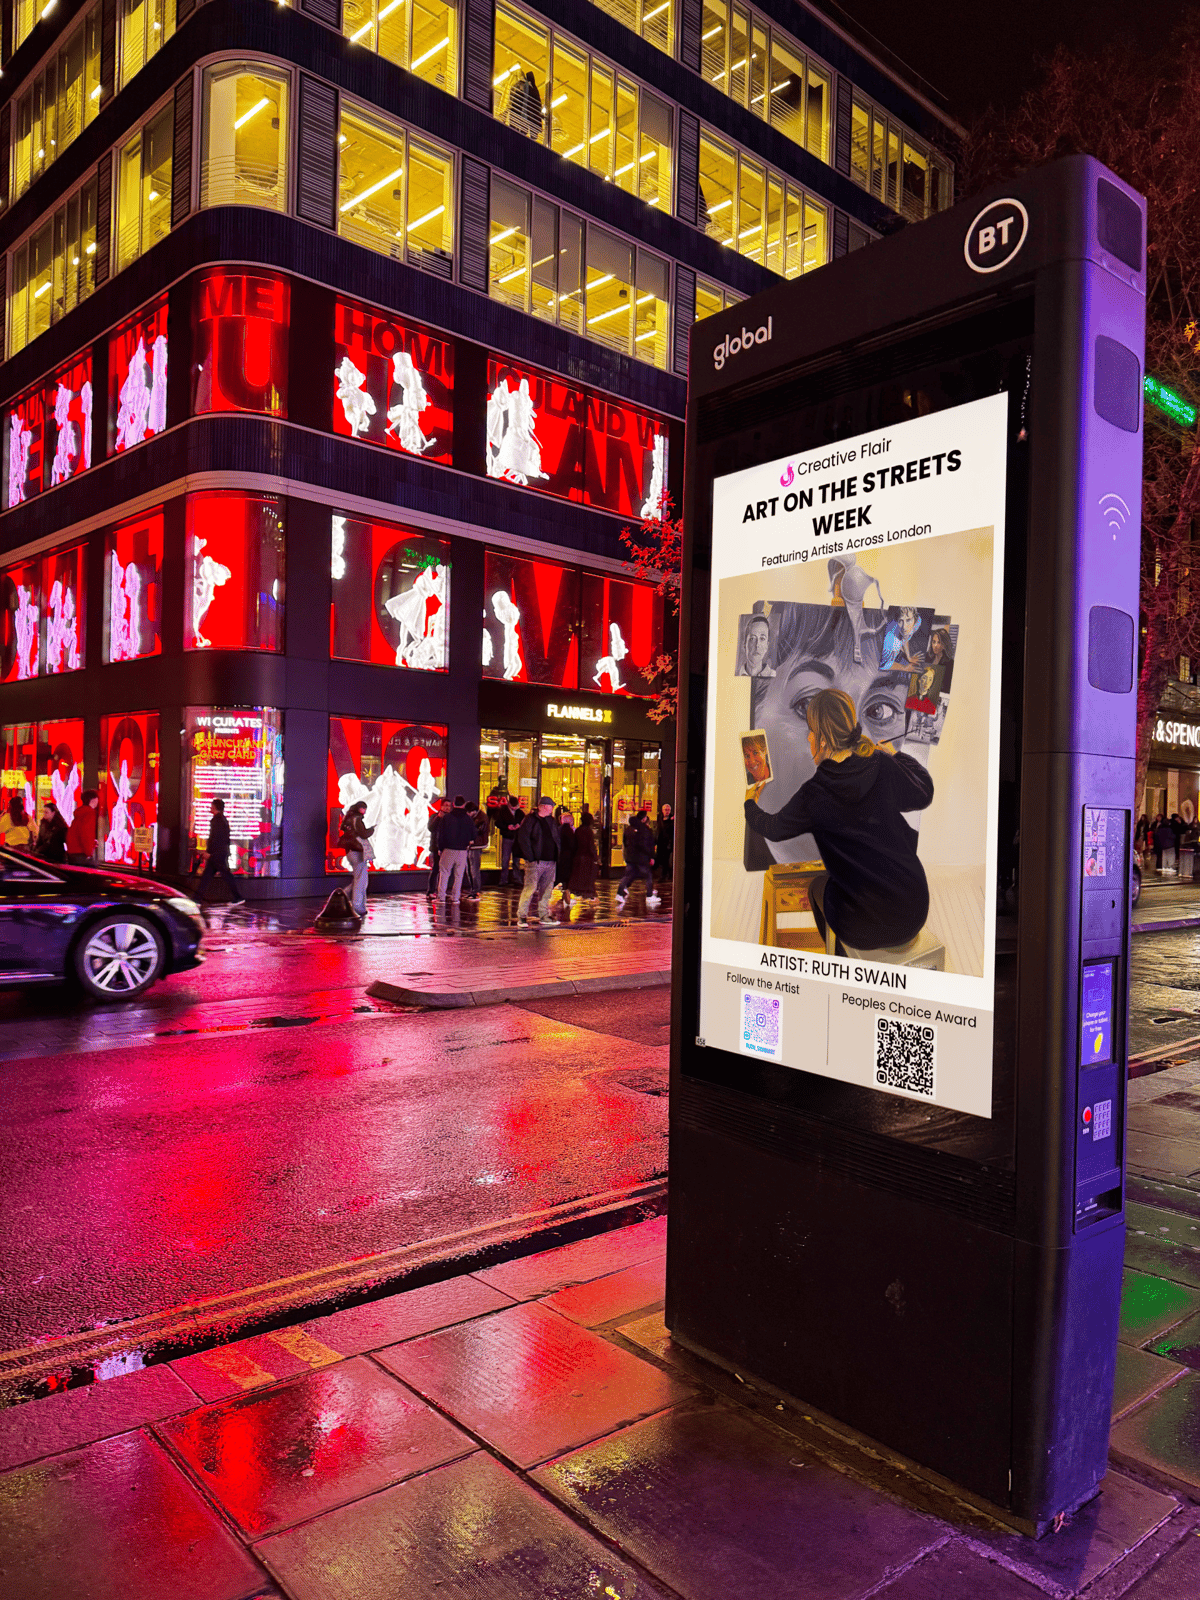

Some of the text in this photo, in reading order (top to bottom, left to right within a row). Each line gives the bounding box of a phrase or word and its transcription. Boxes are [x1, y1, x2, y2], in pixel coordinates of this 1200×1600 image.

[979, 216, 1014, 255] BT
[713, 315, 773, 370] global
[797, 437, 892, 476] Creative Flair
[742, 449, 962, 523] ART ON THE STREETS
[812, 505, 873, 536] WEEK
[761, 522, 932, 567] Featuring Artists Across London
[212, 716, 262, 728] CURATES
[1156, 720, 1165, 742] &
[487, 796, 528, 808] SAE
[726, 971, 800, 995] Follow the Artist
[760, 952, 907, 990] ARTIST: RUTH SWAIN
[842, 992, 977, 1029] Peoples Choice Award
